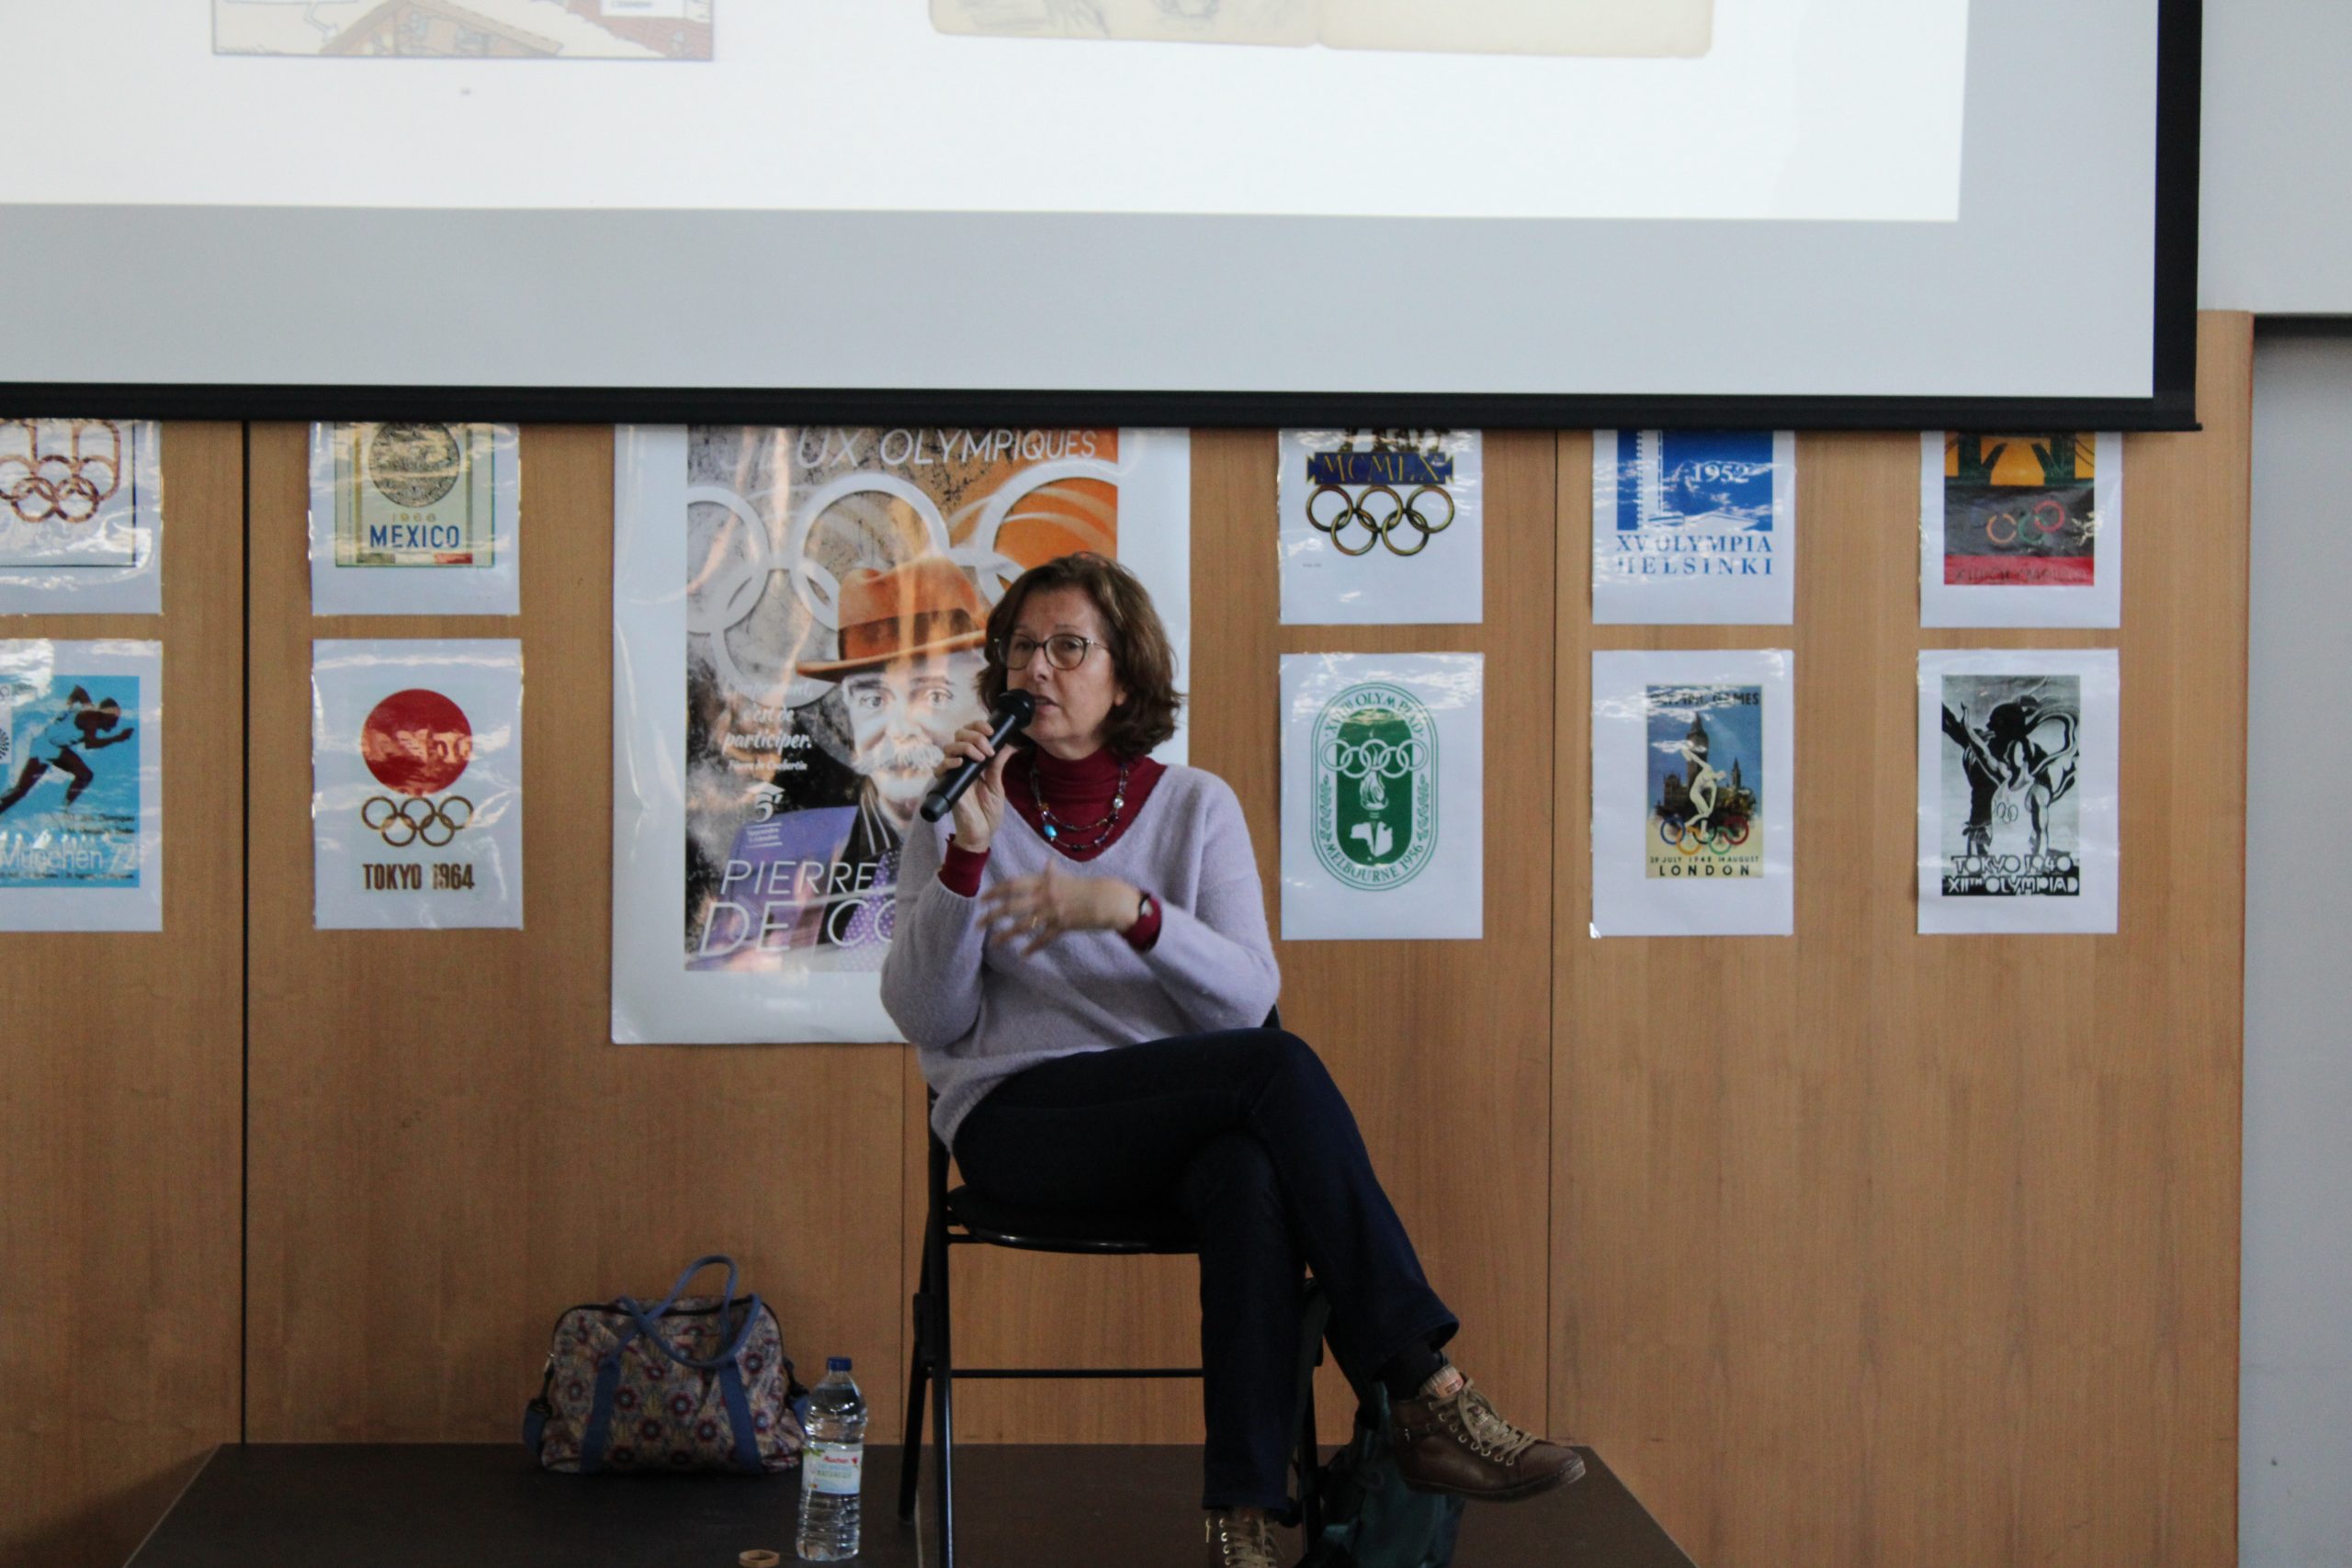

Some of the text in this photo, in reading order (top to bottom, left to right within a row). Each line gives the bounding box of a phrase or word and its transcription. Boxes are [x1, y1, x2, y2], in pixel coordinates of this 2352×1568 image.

[879, 428, 1098, 466] OLYMPIQUES
[1693, 464, 1750, 483] 1952
[369, 525, 459, 548] MEXICO
[1616, 535, 1773, 553] XV OLYMPIA
[1618, 558, 1773, 575] HELSINKI
[722, 730, 813, 757] participer.
[1325, 843, 1424, 882] MELBOURNE 1956
[1659, 864, 1749, 876] LONDON
[1952, 855, 2072, 873] TOKYO 1940
[362, 863, 476, 890] TOKYO 1964
[719, 859, 878, 896] PIERRE
[1985, 876, 2079, 893] OLYMPIAD
[699, 900, 799, 957] DE
